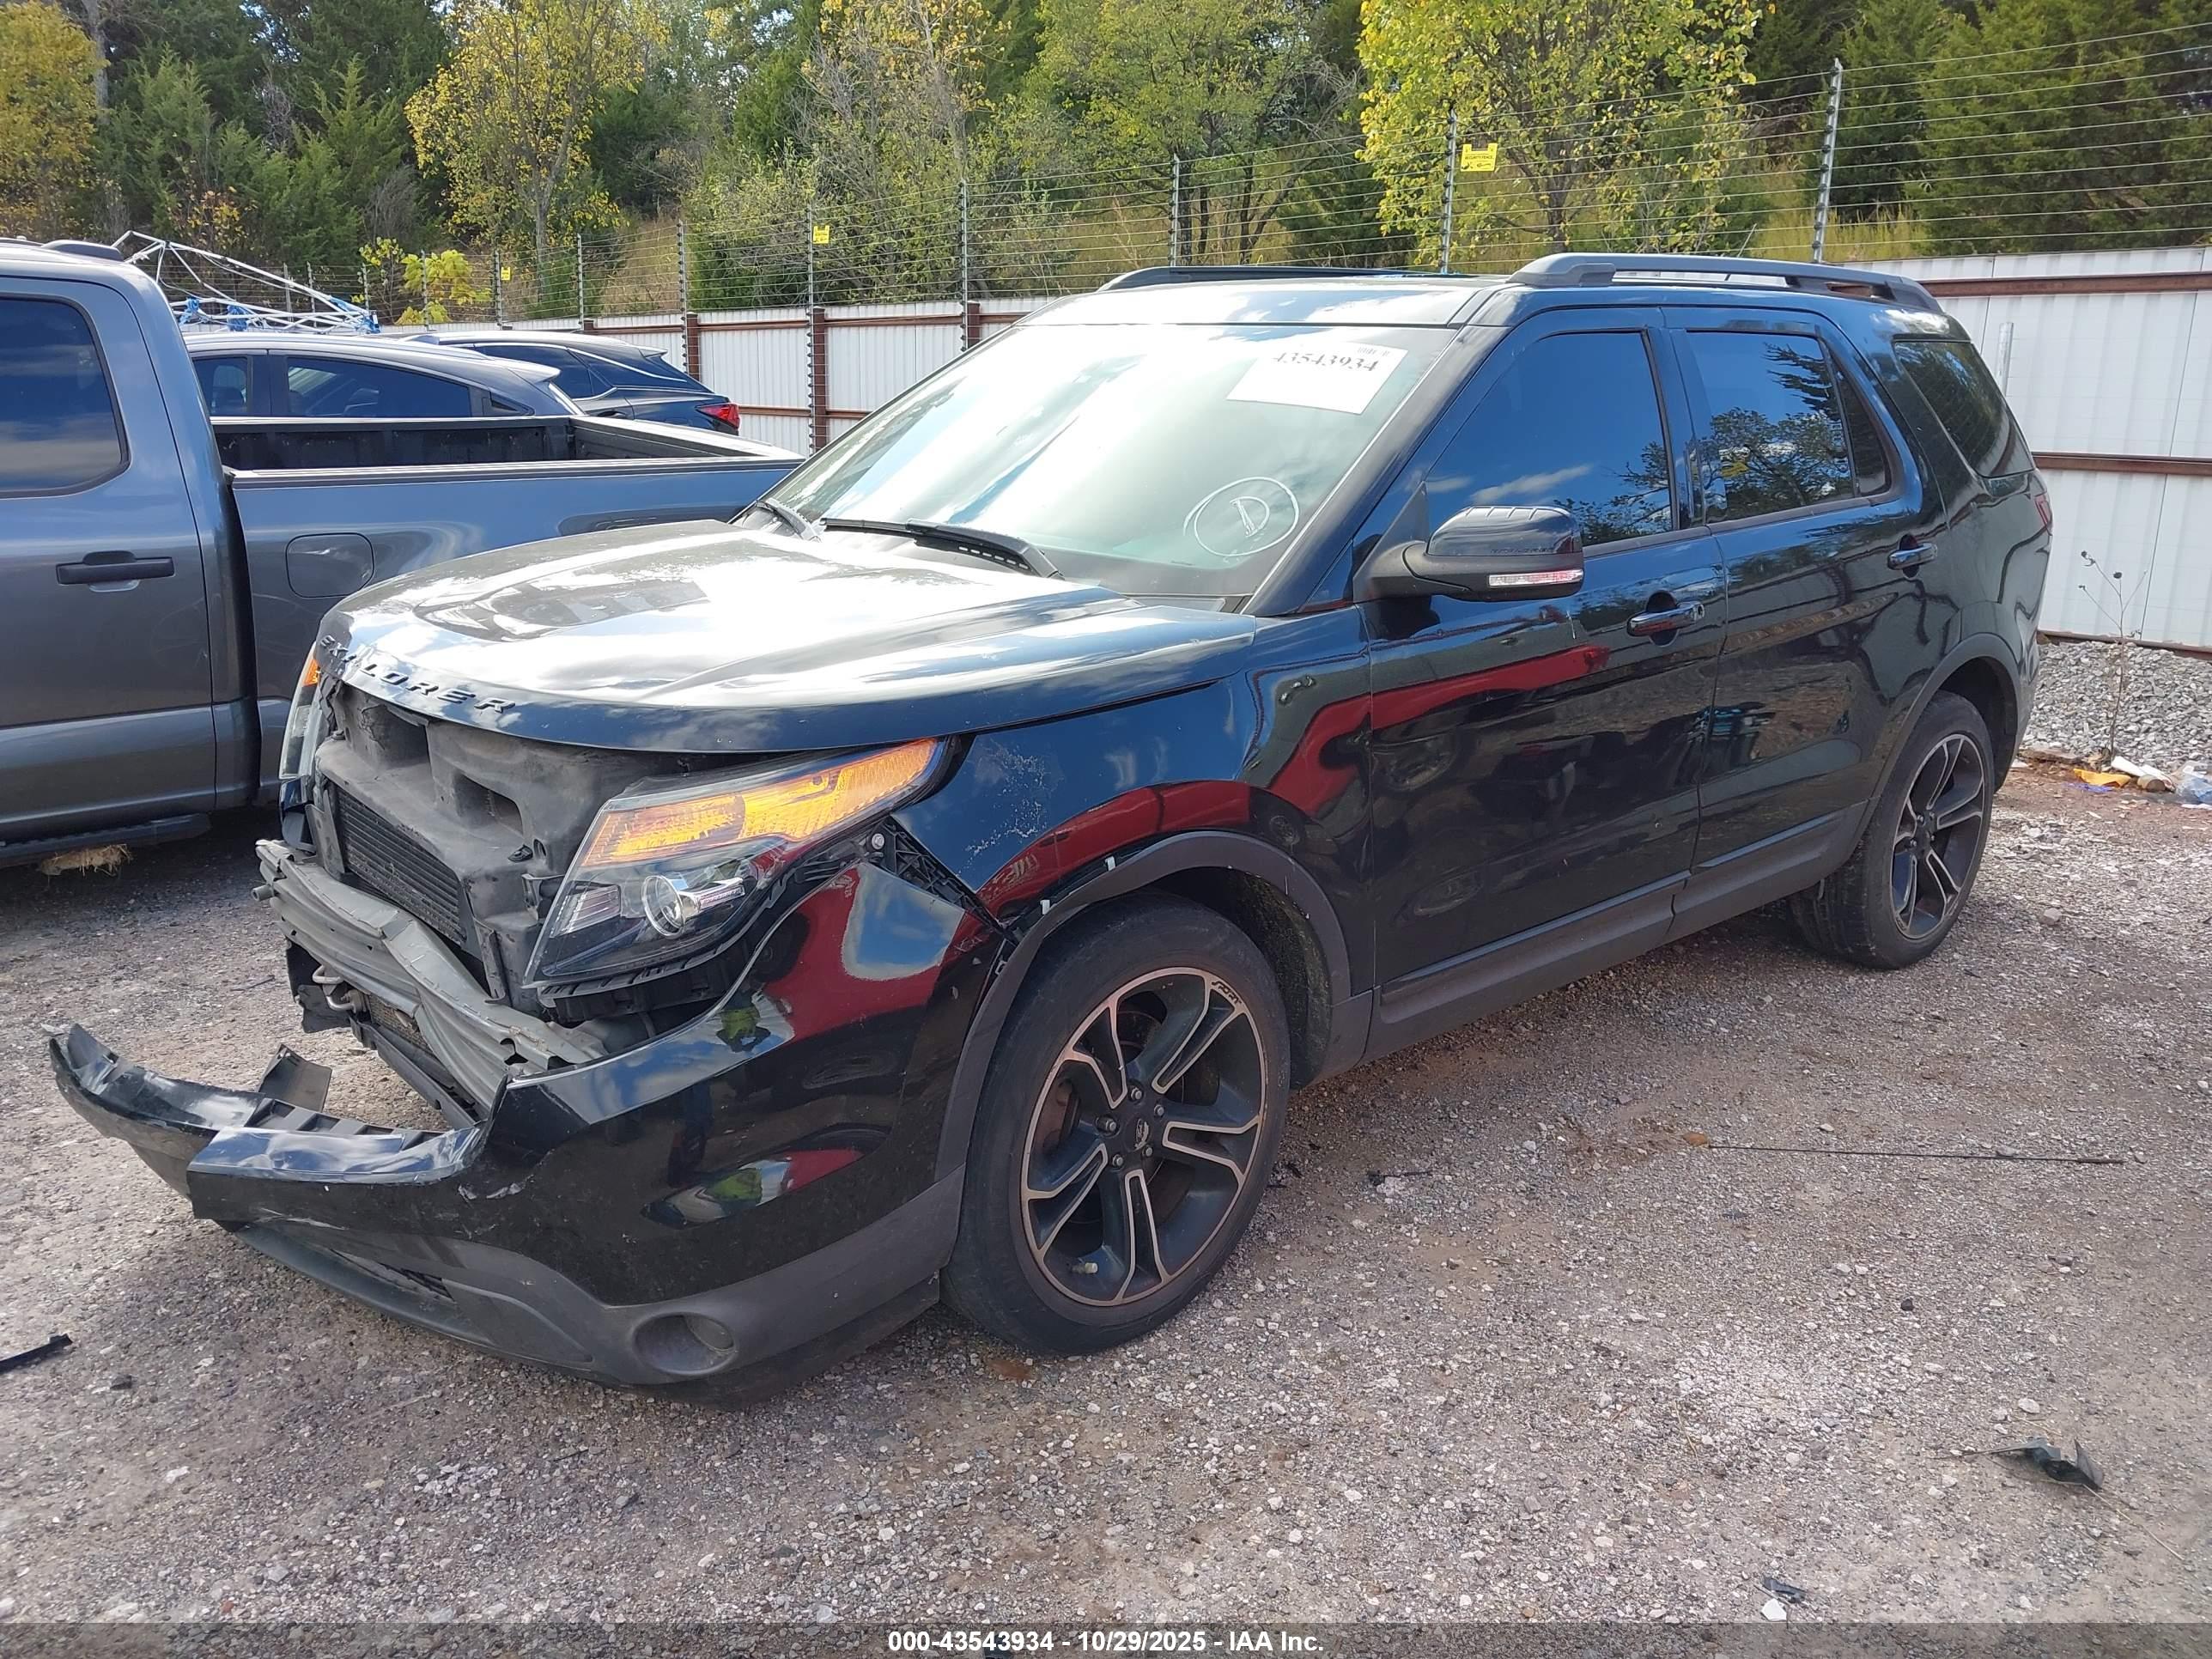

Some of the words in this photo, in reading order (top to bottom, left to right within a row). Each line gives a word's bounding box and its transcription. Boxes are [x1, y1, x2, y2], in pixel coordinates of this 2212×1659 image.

[1272, 352, 1379, 372] 43543934
[1230, 495, 1270, 537] D
[1211, 980, 1243, 1006] SPORT
